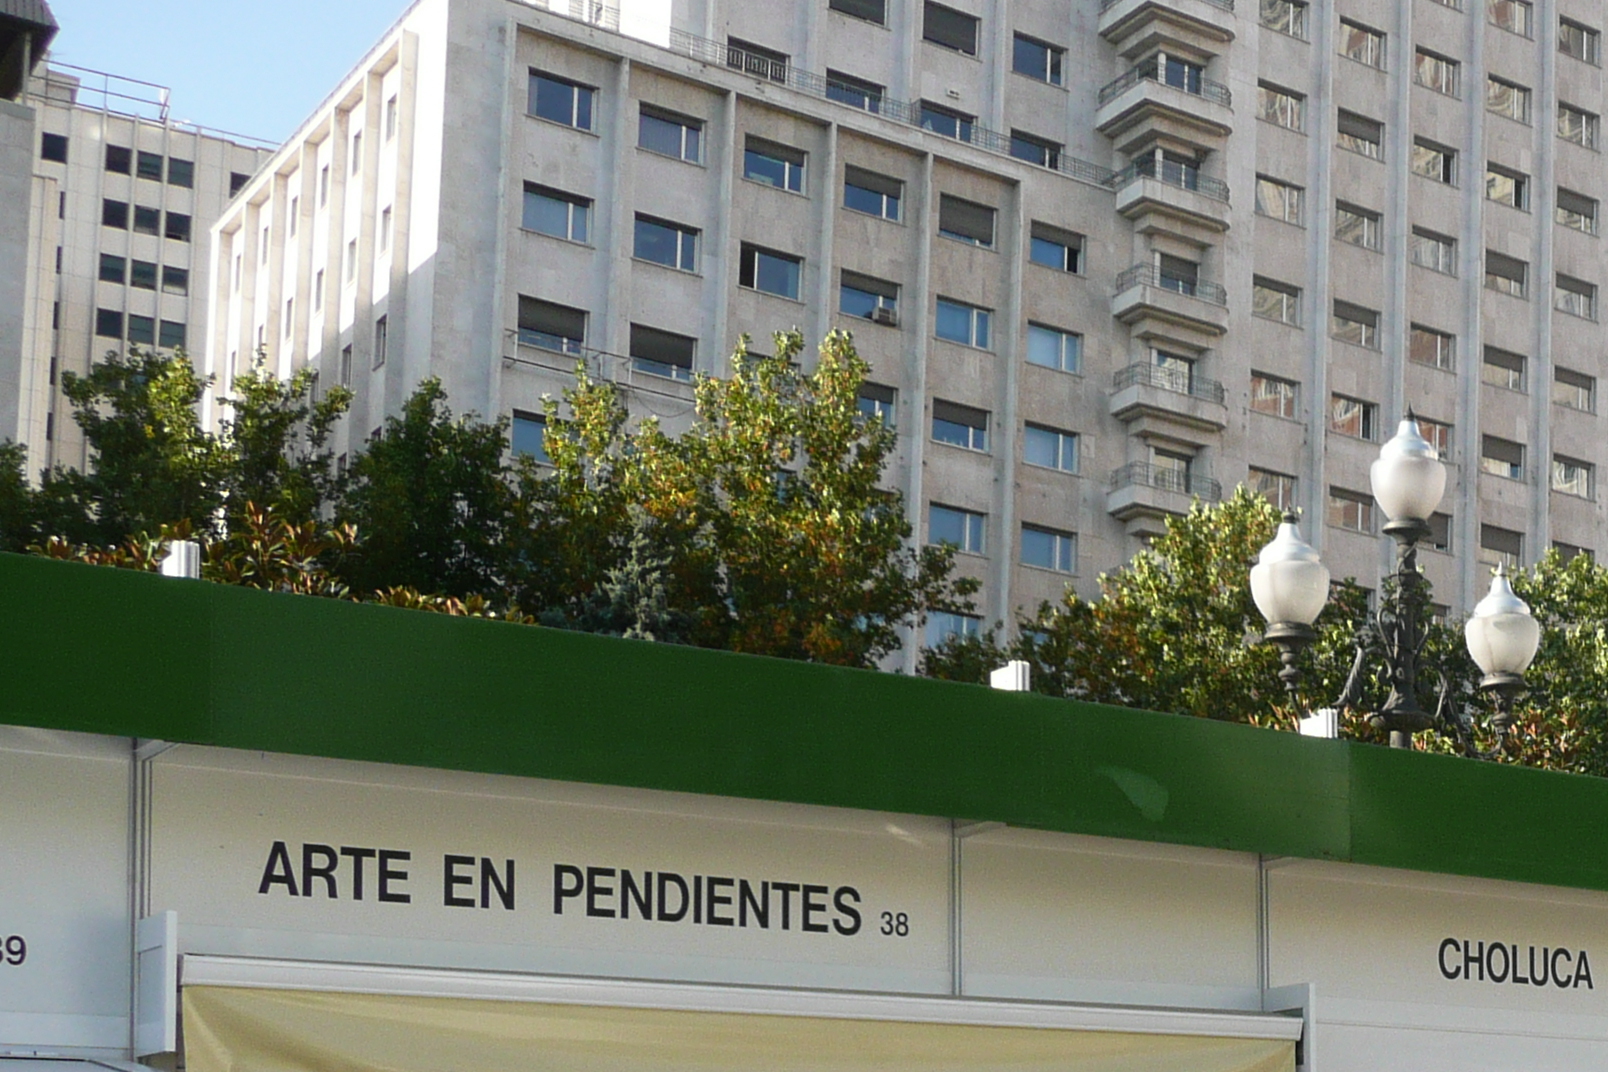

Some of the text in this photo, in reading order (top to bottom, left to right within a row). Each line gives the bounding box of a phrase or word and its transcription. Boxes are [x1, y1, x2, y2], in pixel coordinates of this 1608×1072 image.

[258, 840, 862, 937] ARTE EN PENDIENTES
[879, 910, 910, 937] 38
[1437, 936, 1595, 991] CHOLUCA
